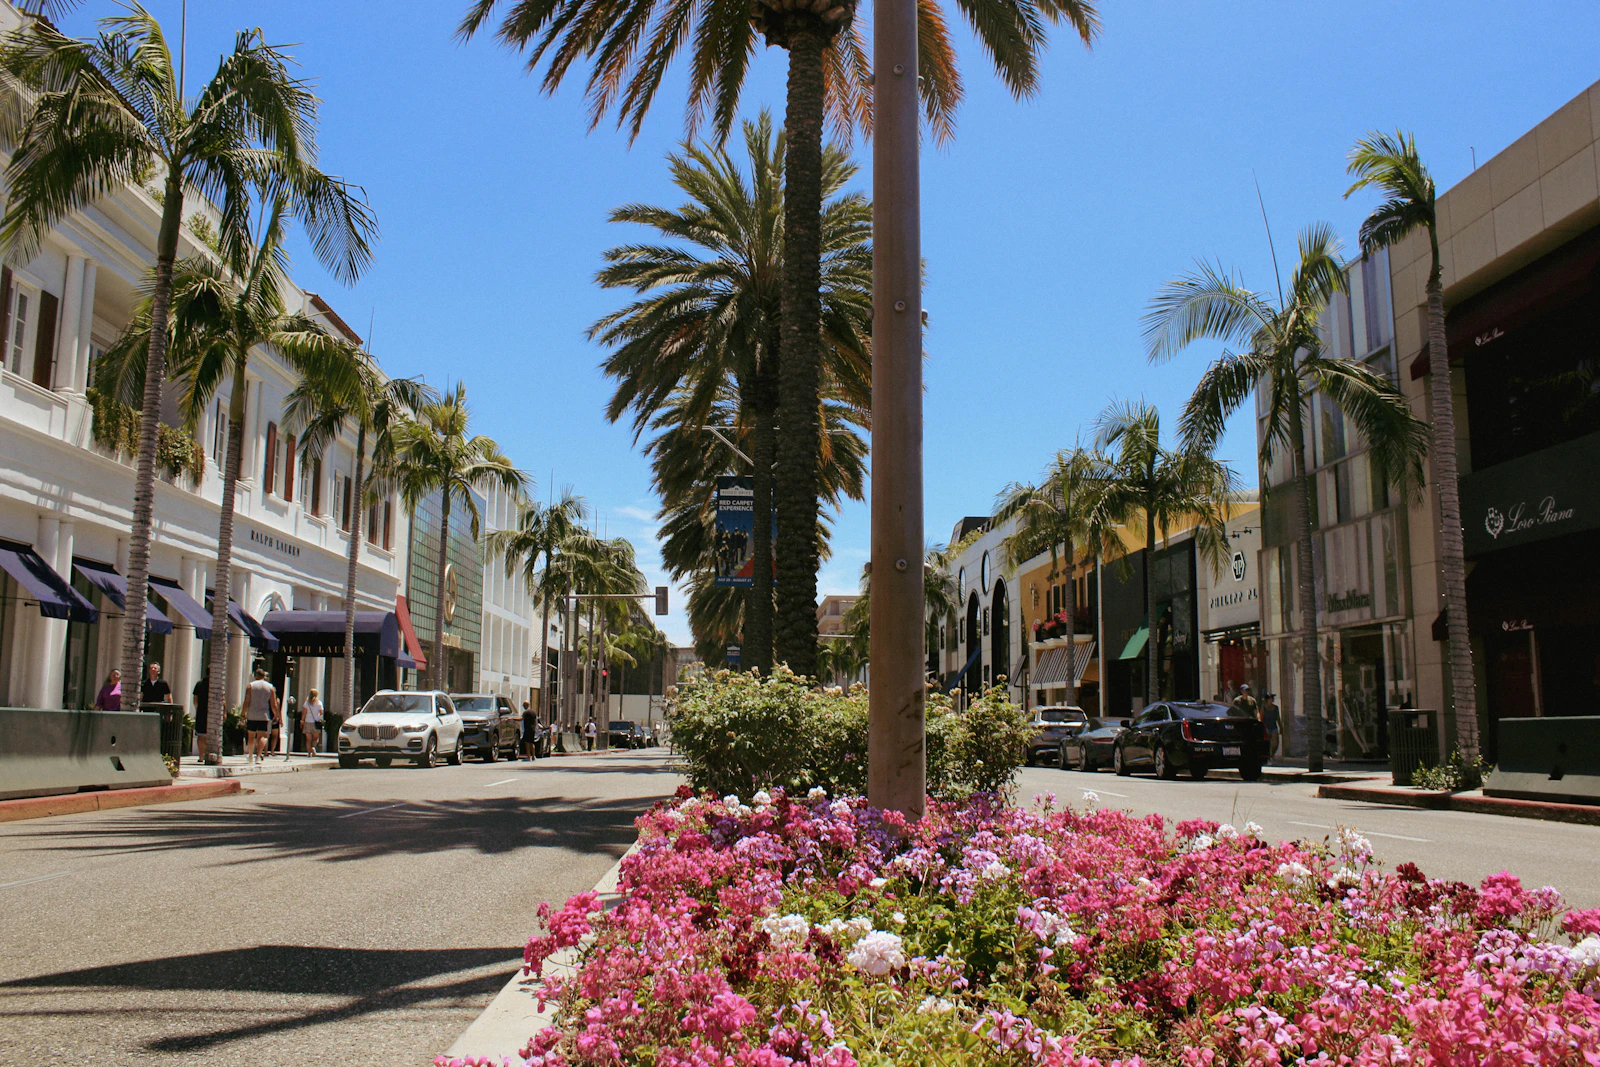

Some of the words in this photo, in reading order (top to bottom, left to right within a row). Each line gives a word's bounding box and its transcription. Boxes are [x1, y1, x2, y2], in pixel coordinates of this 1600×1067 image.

[1504, 502, 1534, 533] Loro
[1537, 496, 1574, 525] Piana
[250, 530, 273, 548] RALPH
[276, 540, 300, 557] LAUREN
[1209, 592, 1242, 608] PHILIPP
